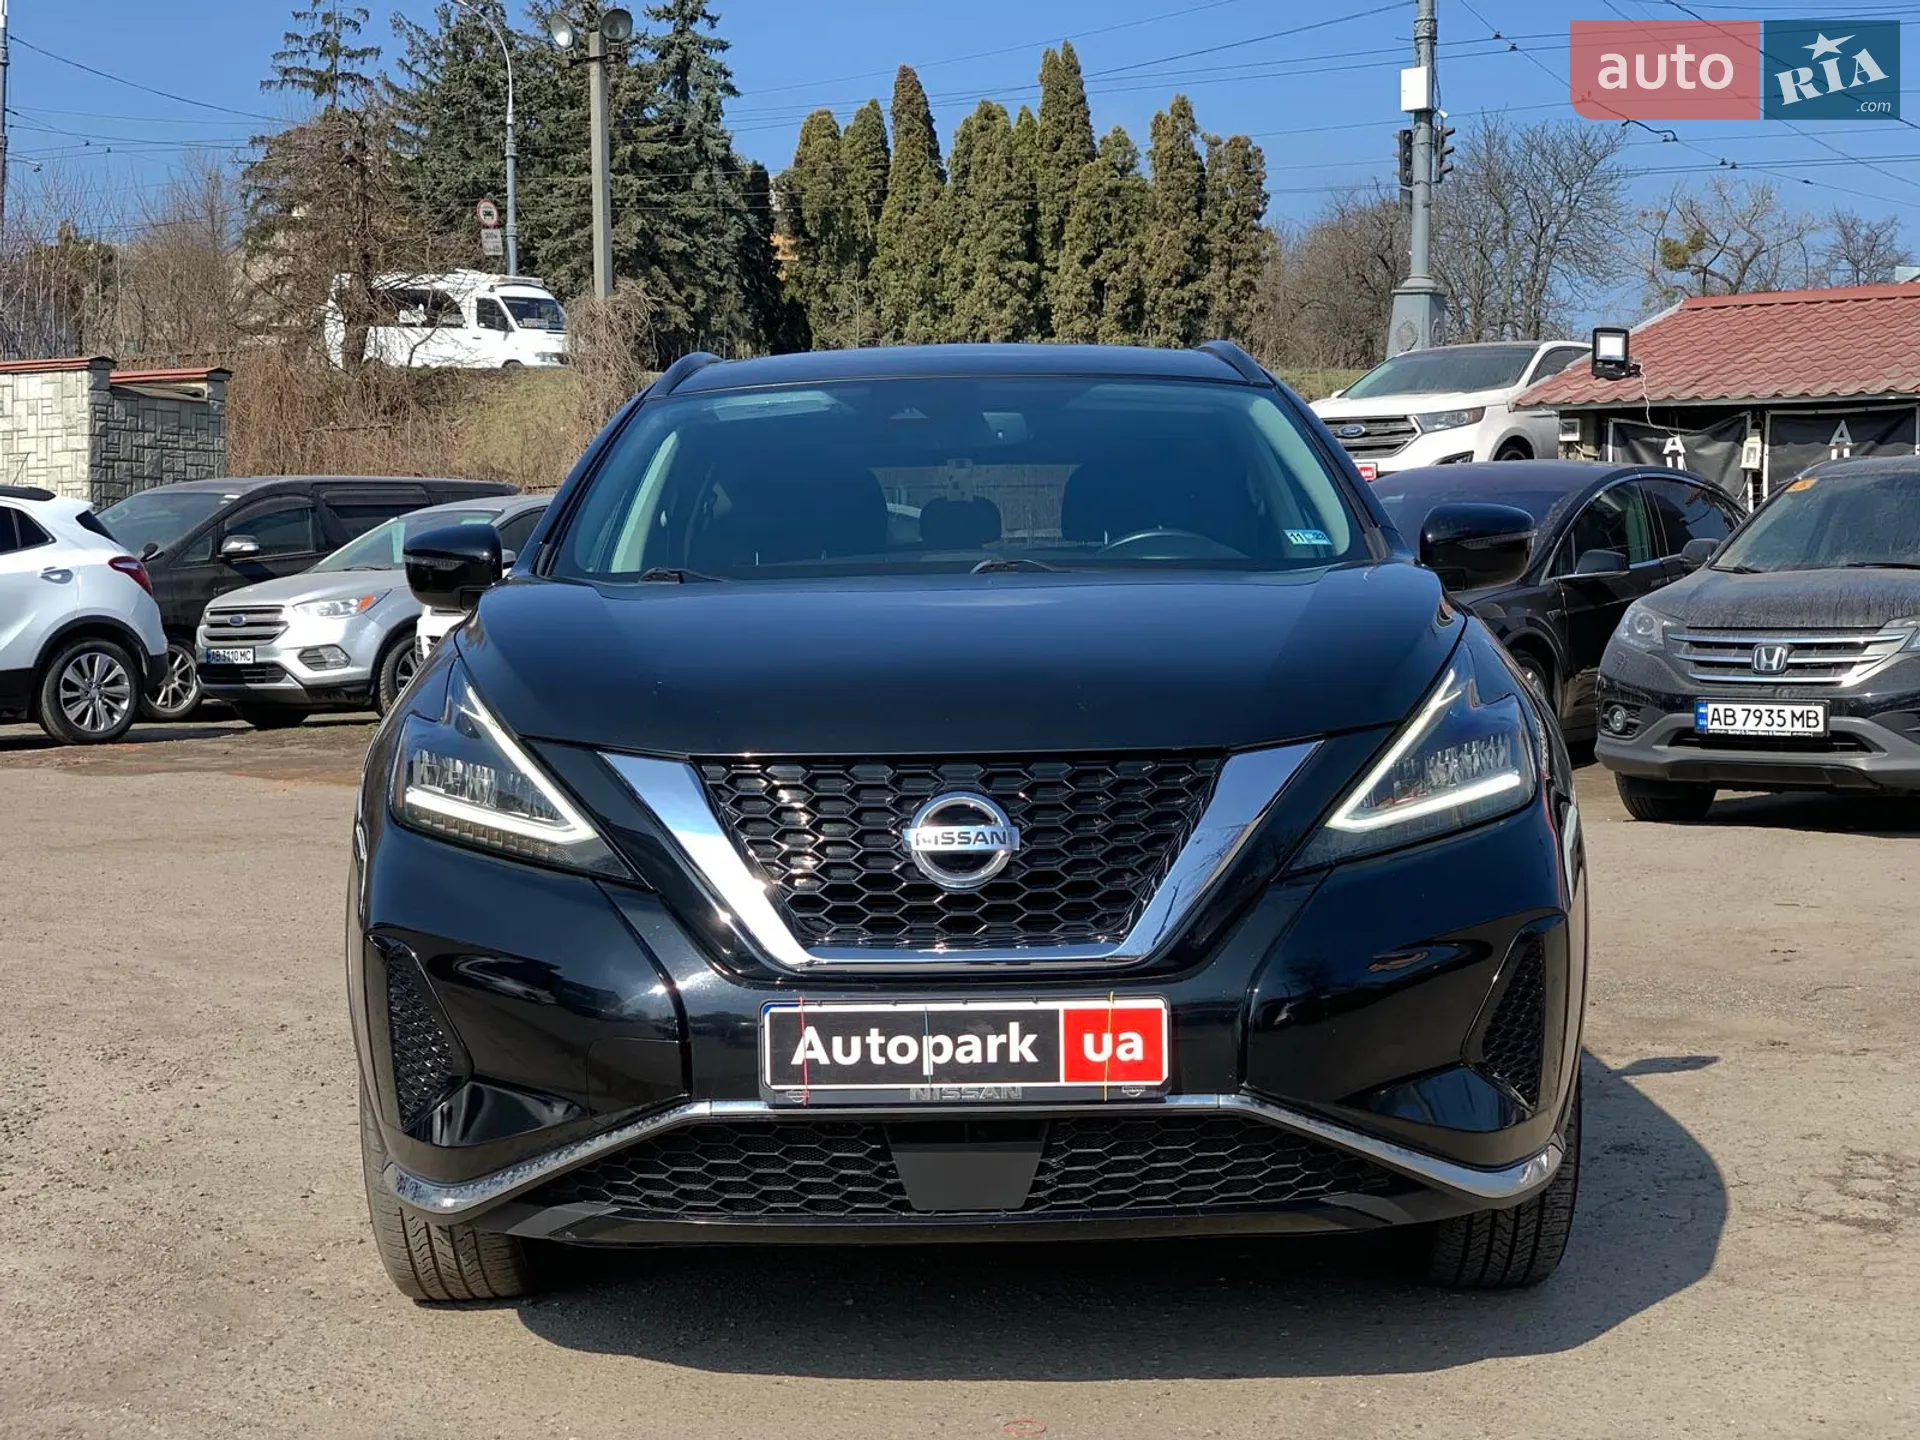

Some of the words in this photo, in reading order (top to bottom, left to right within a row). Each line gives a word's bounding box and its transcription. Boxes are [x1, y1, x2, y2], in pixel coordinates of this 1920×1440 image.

[1710, 707, 1737, 727] AB
[1740, 708, 1787, 728] 7935
[1791, 709, 1820, 729] MB
[915, 831, 1007, 846] NISSAN
[790, 1021, 1038, 1076] Autopark
[1083, 1031, 1144, 1062] ua
[909, 1086, 1022, 1101] NISSAN
